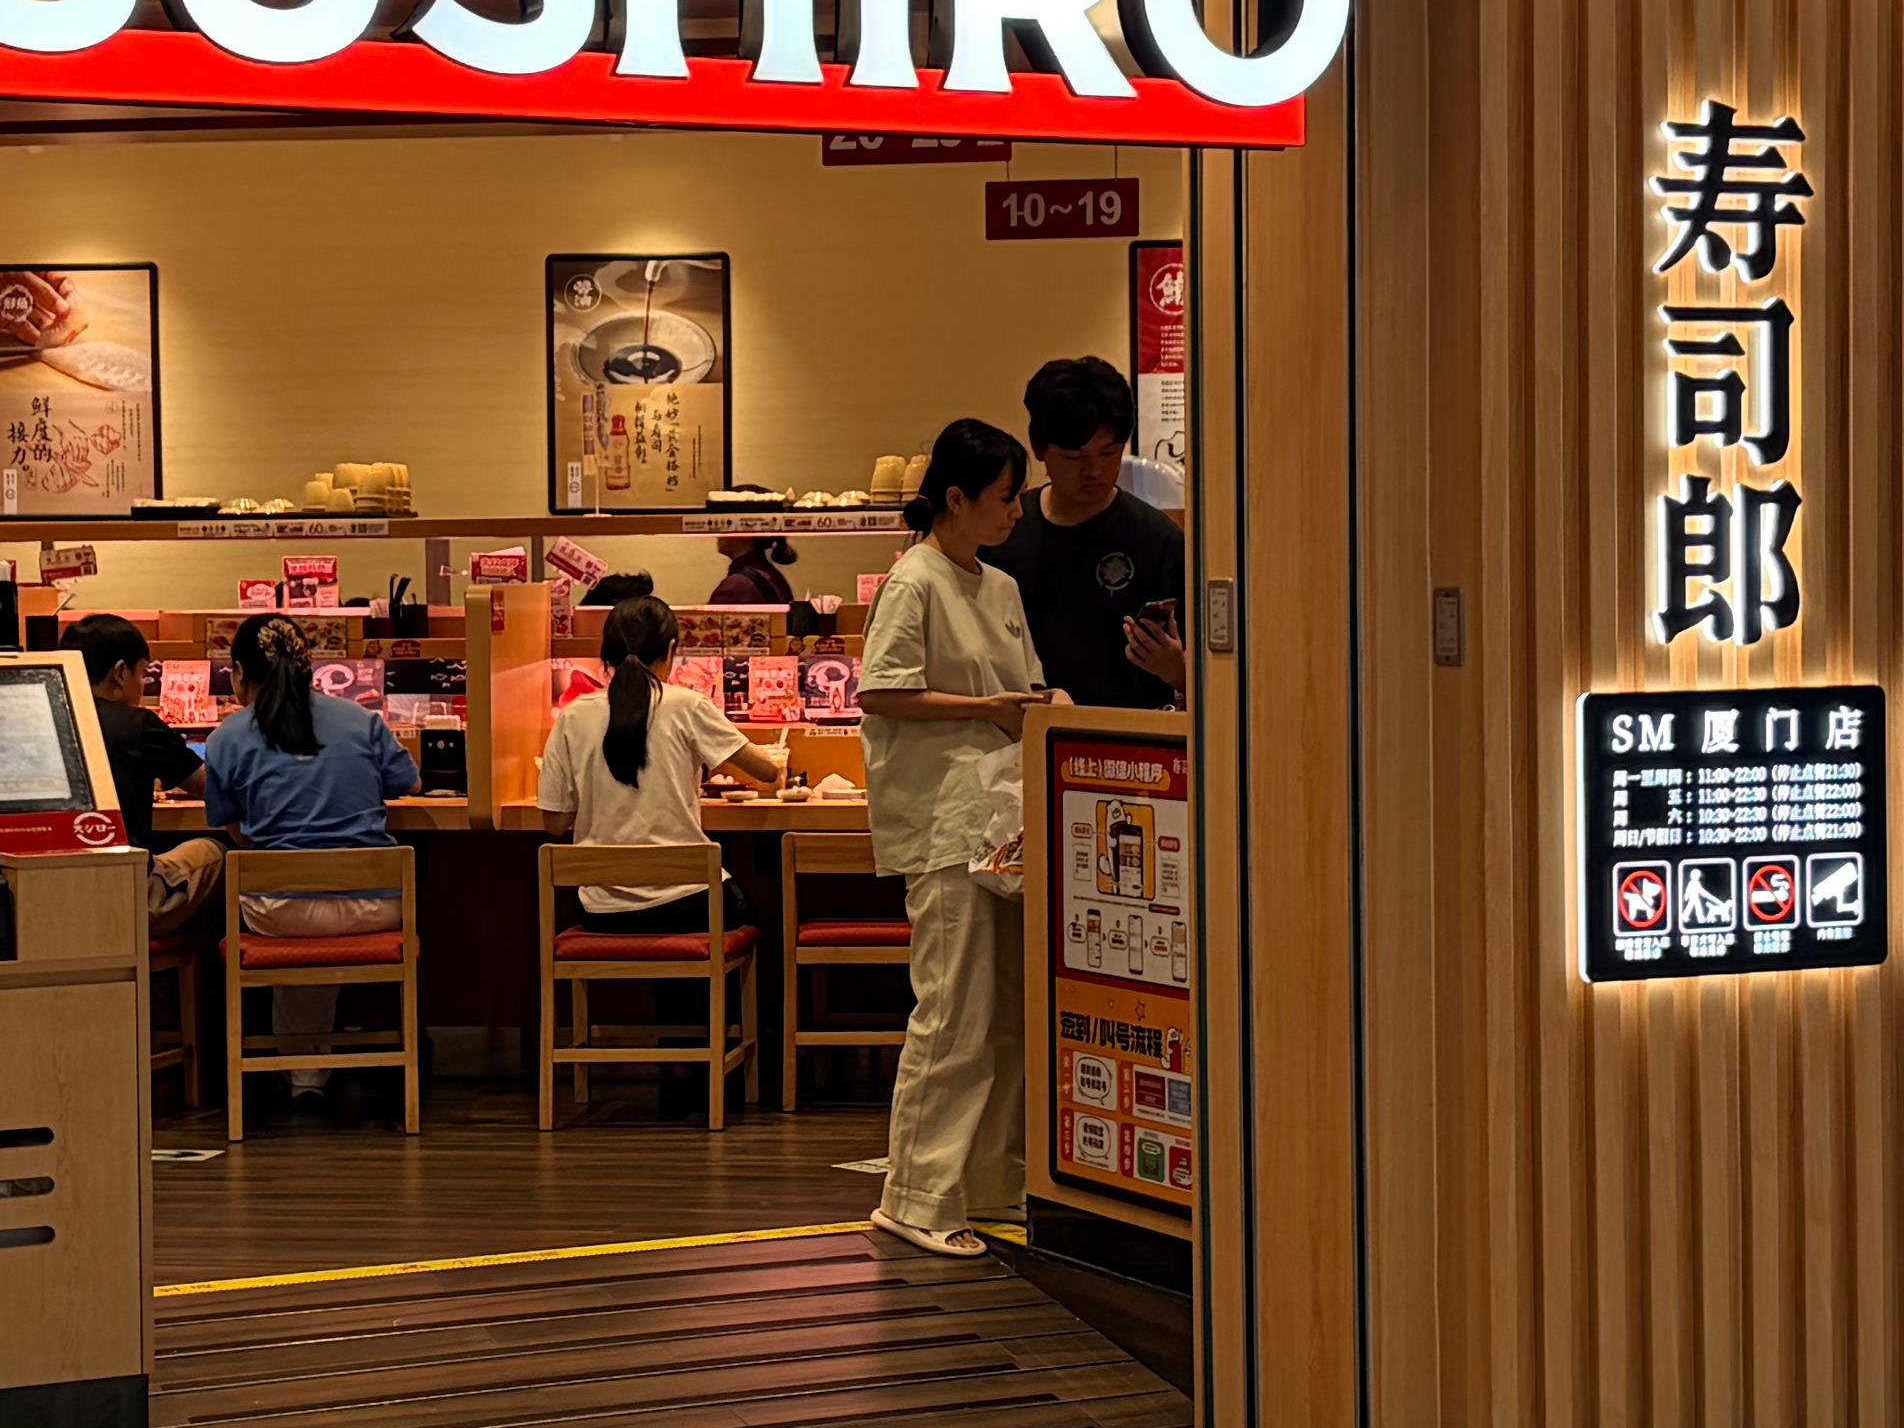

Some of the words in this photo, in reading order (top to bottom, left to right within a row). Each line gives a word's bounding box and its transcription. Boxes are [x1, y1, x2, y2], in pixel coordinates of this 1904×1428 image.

[1002, 191, 1122, 228] 10~19
[1650, 99, 1813, 647] 寿司郎
[1611, 713, 1676, 754] SM
[1701, 705, 1864, 754] 厦门店
